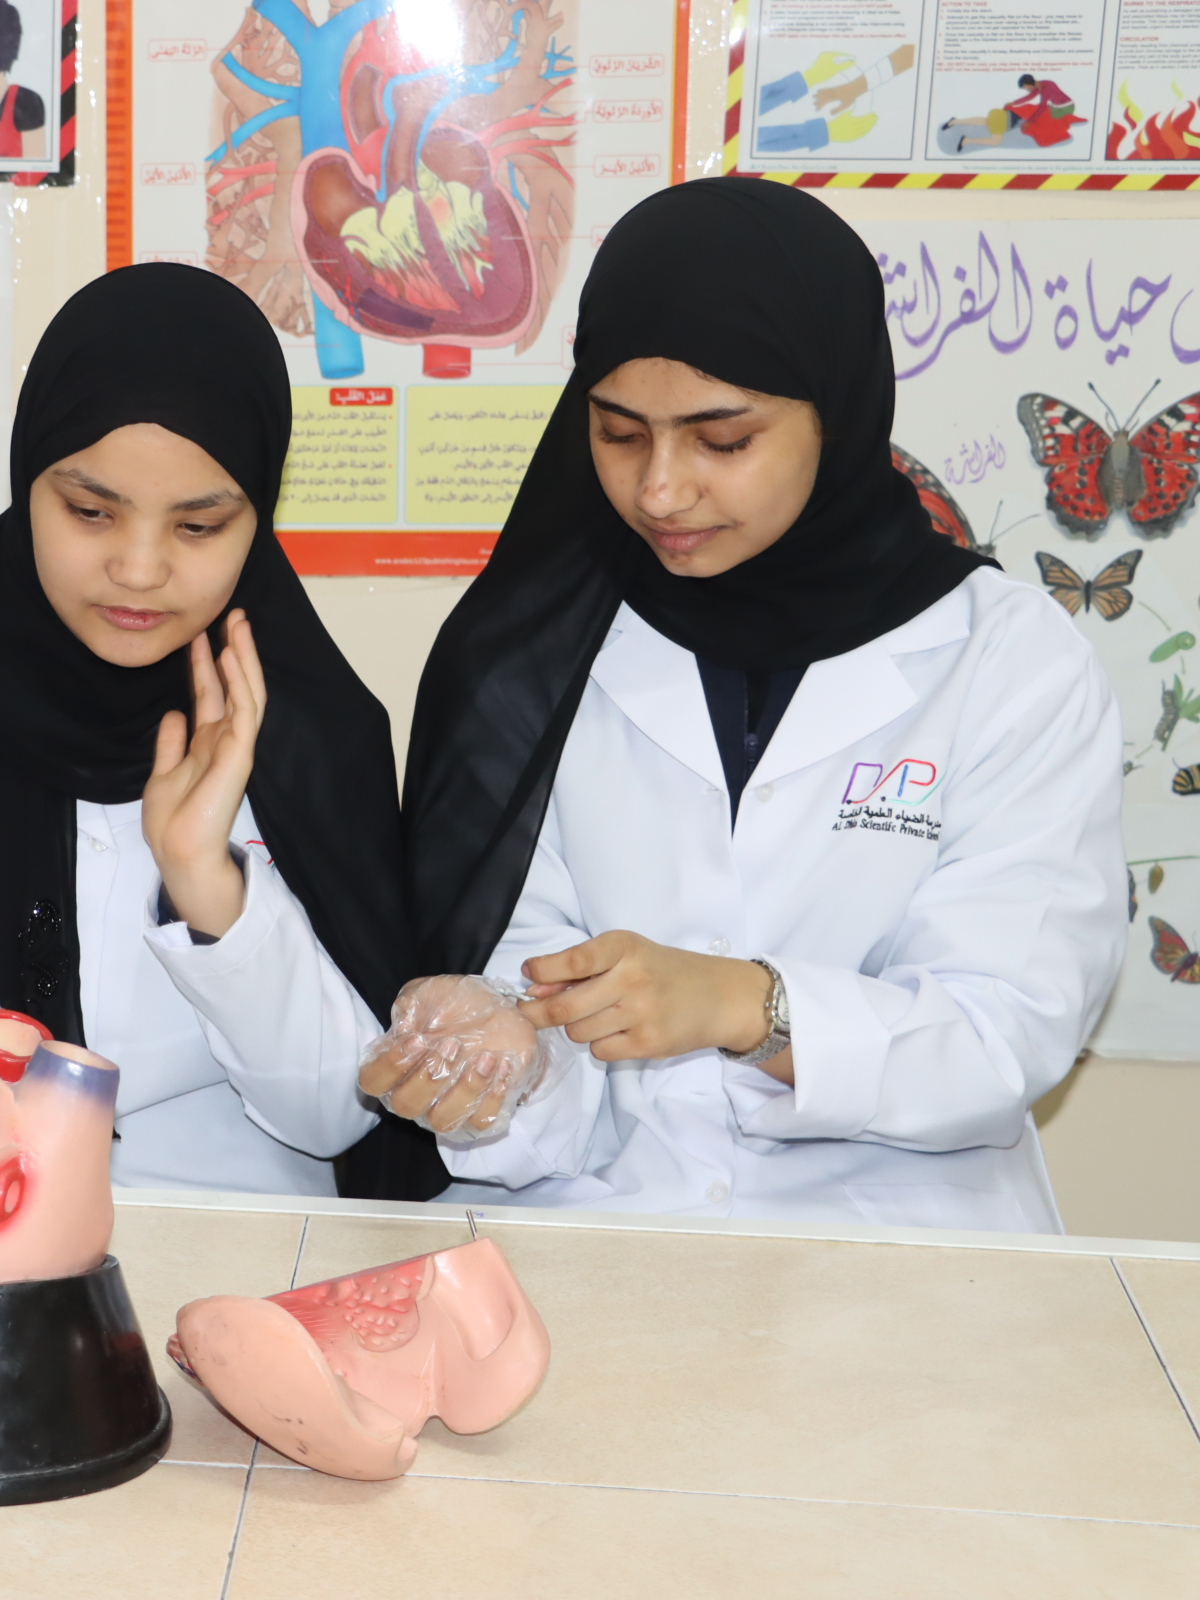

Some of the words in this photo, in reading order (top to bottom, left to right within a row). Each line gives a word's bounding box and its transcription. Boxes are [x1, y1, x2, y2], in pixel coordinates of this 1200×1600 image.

[1043, 257, 1173, 367] حياة
[943, 433, 1007, 486] الفراشة
[899, 823, 925, 838] Private
